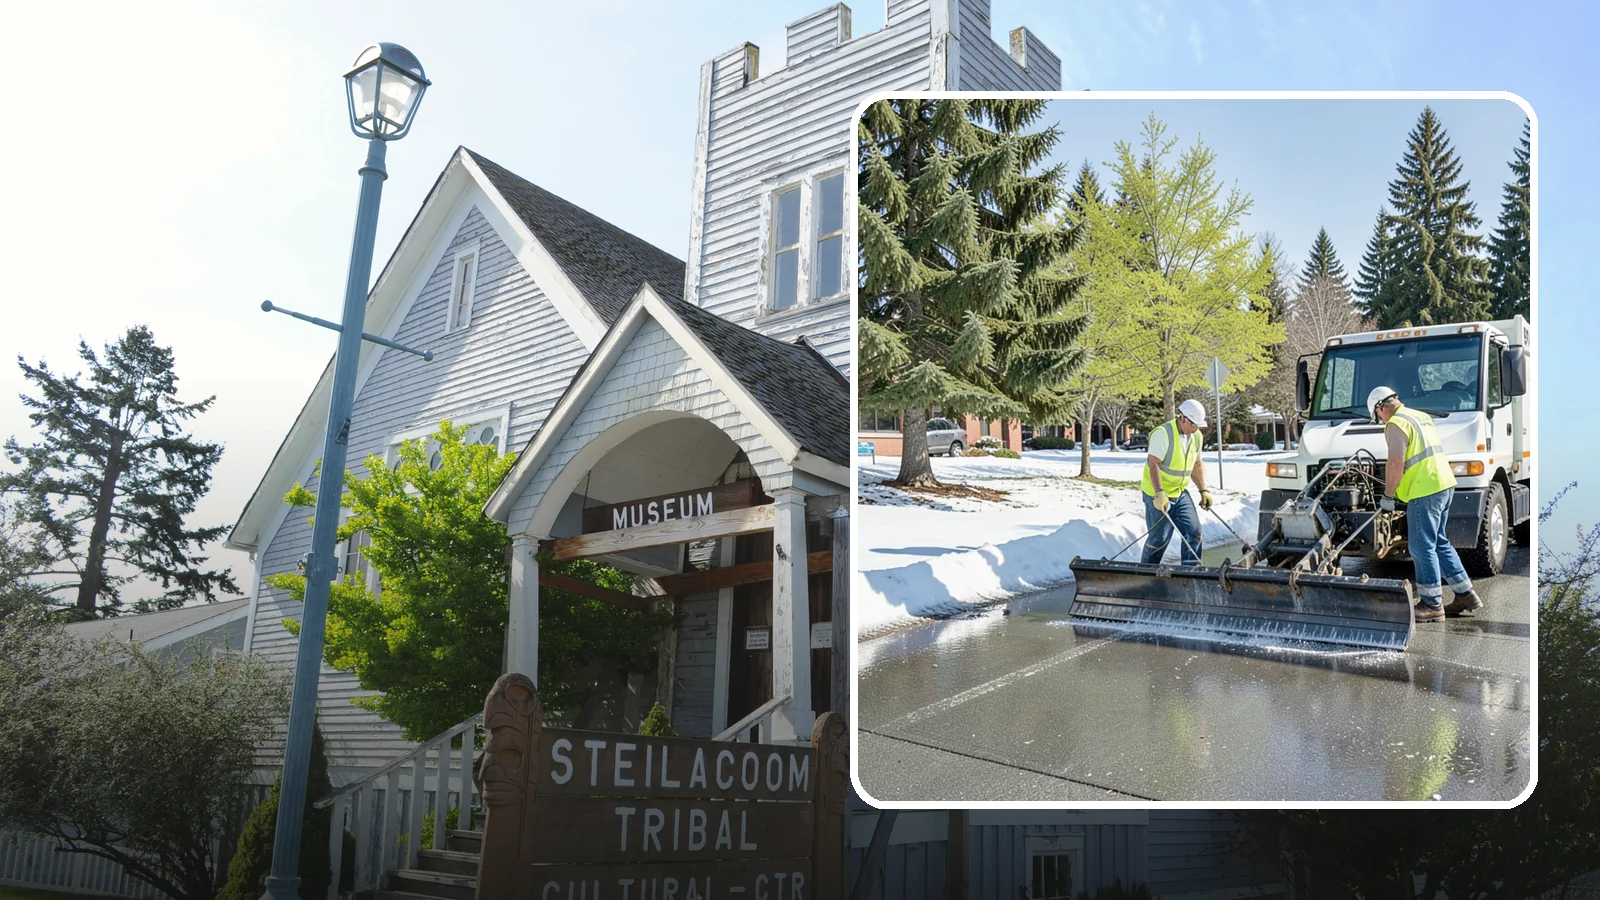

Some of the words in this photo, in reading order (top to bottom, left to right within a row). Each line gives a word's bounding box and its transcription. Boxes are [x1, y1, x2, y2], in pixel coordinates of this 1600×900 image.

[613, 492, 713, 530] MUSEUM
[551, 738, 809, 792] STEILACOOM
[615, 807, 757, 852] TRIBAL
